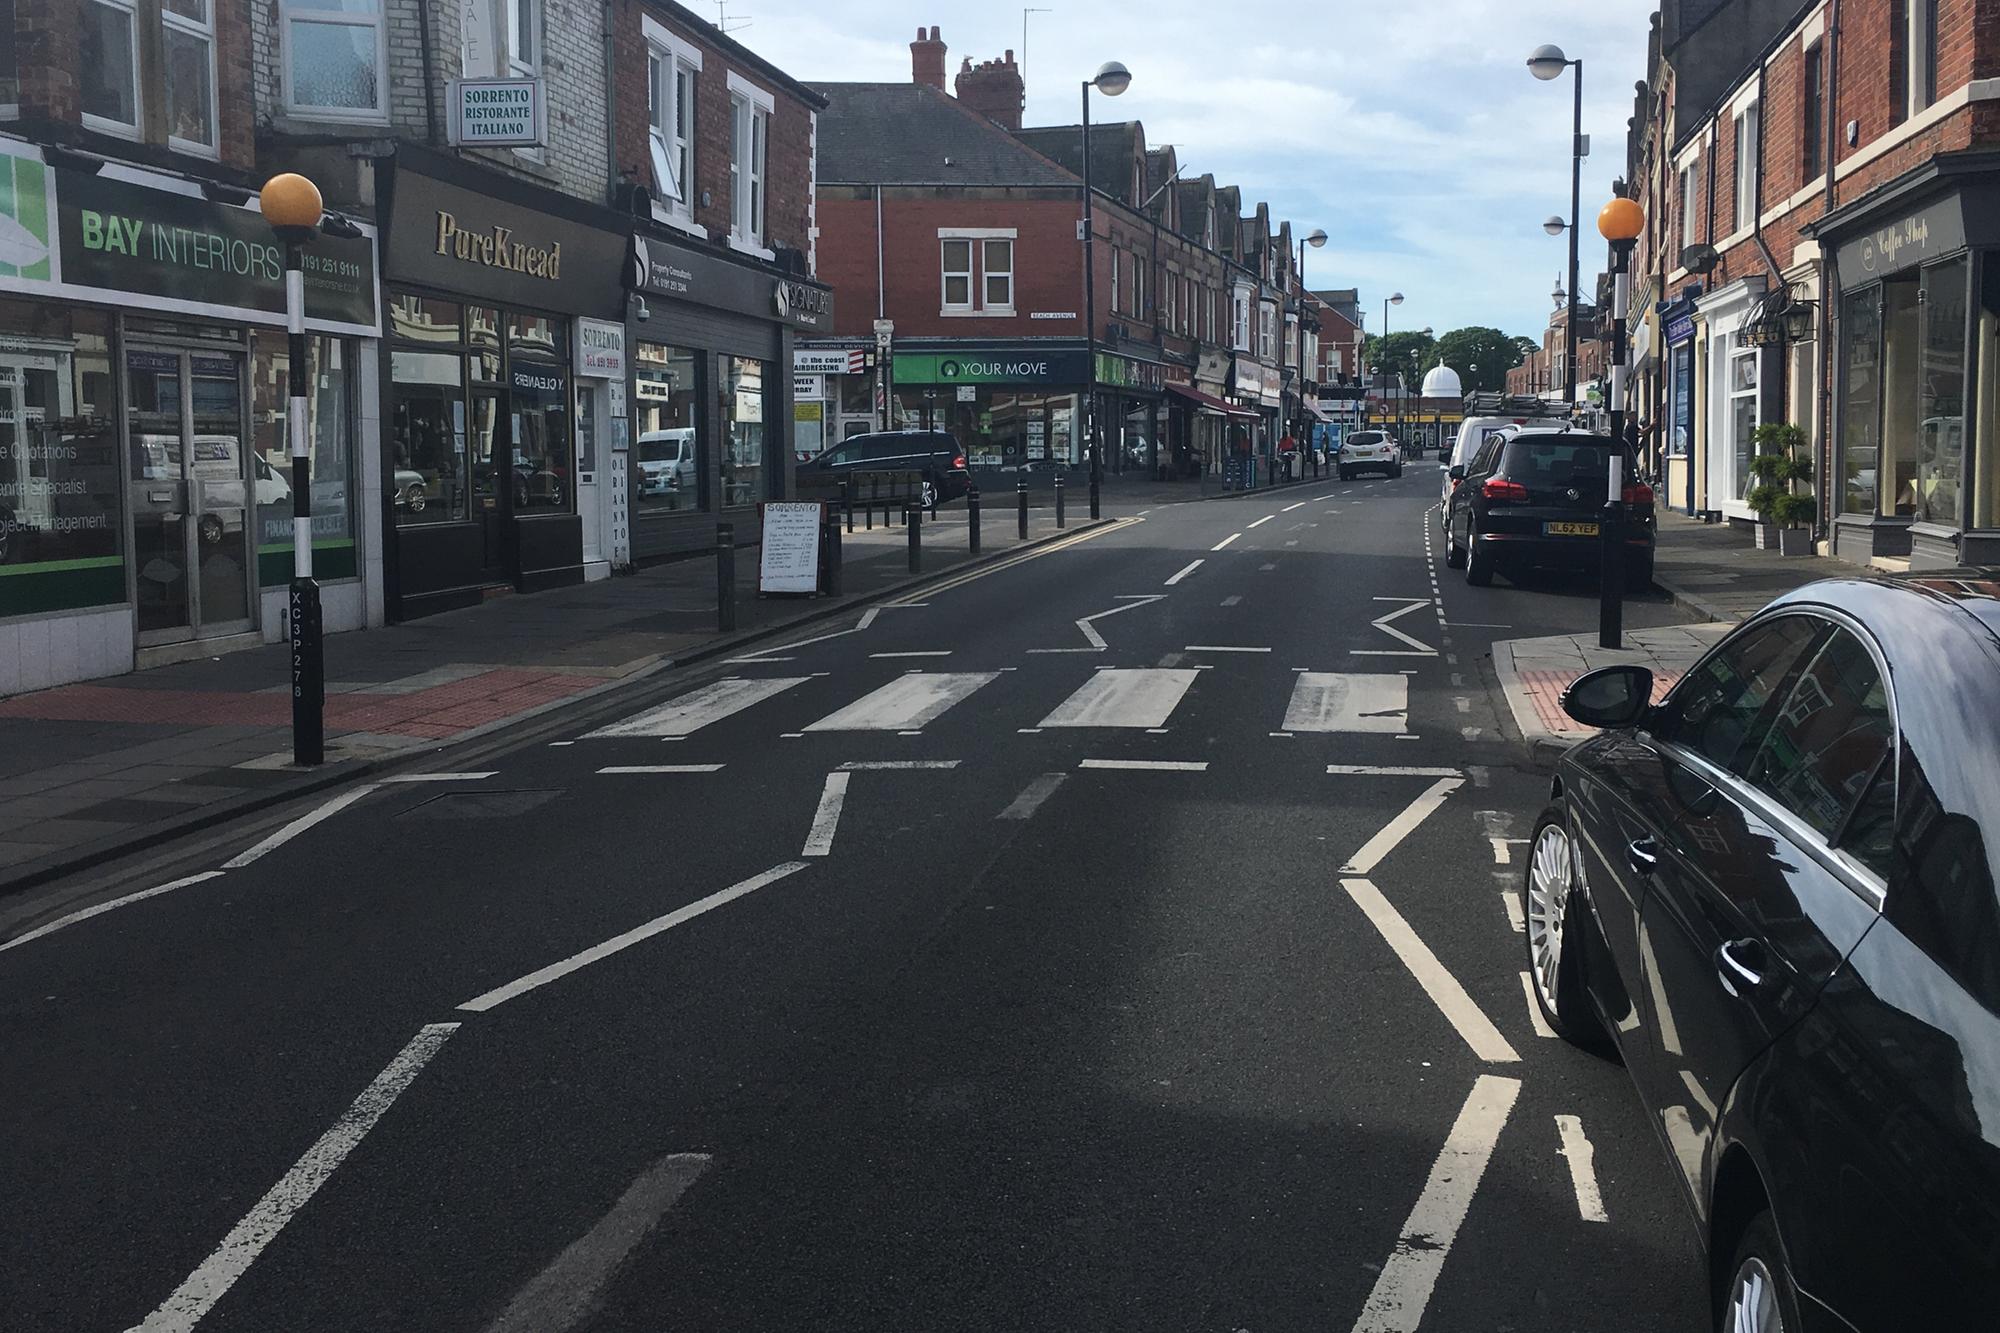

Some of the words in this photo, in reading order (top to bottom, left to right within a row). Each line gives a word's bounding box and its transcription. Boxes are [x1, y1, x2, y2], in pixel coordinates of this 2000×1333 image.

[465, 90, 529, 103] SORRENTO
[465, 107, 530, 119] RISTORANTE
[472, 123, 524, 135] ITALIANO
[82, 209, 143, 257] BAY
[152, 223, 281, 281] INTERIORS
[436, 210, 560, 280] PureKnead
[1877, 226, 1902, 262] Coffee
[1905, 217, 1928, 248] Shop
[322, 257, 337, 274] 251
[340, 261, 360, 278] 9111
[790, 284, 828, 314] SIGNATURE
[583, 328, 620, 351] SORRENTO
[961, 362, 1002, 376] YOUR
[1005, 362, 1047, 376] MOVE
[11, 441, 77, 461] Quotations
[31, 480, 87, 495] Specialist
[265, 519, 295, 538] FINANC
[1550, 524, 1575, 533] NL62
[1577, 525, 1597, 534] YEF
